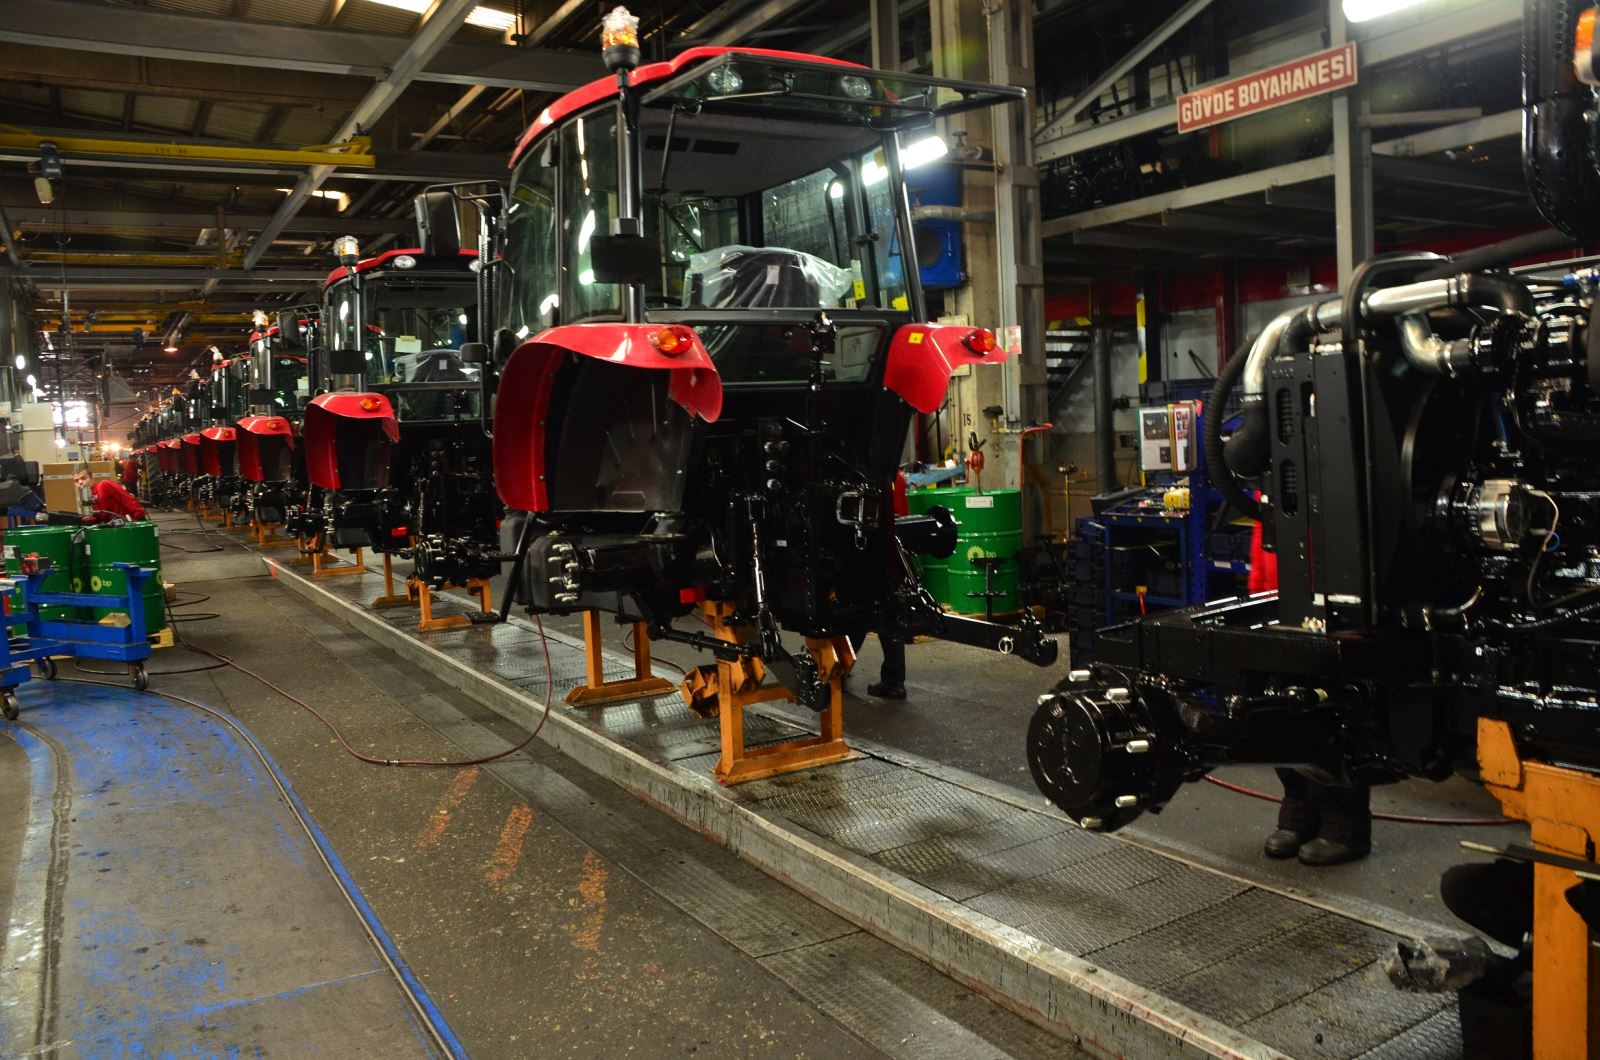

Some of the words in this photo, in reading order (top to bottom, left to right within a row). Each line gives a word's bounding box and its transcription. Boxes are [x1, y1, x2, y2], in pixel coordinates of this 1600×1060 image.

[1182, 89, 1235, 123] GÖVDE
[1238, 48, 1352, 108] BOYAHANESİ
[963, 413, 972, 427] 15
[102, 579, 112, 588] bp
